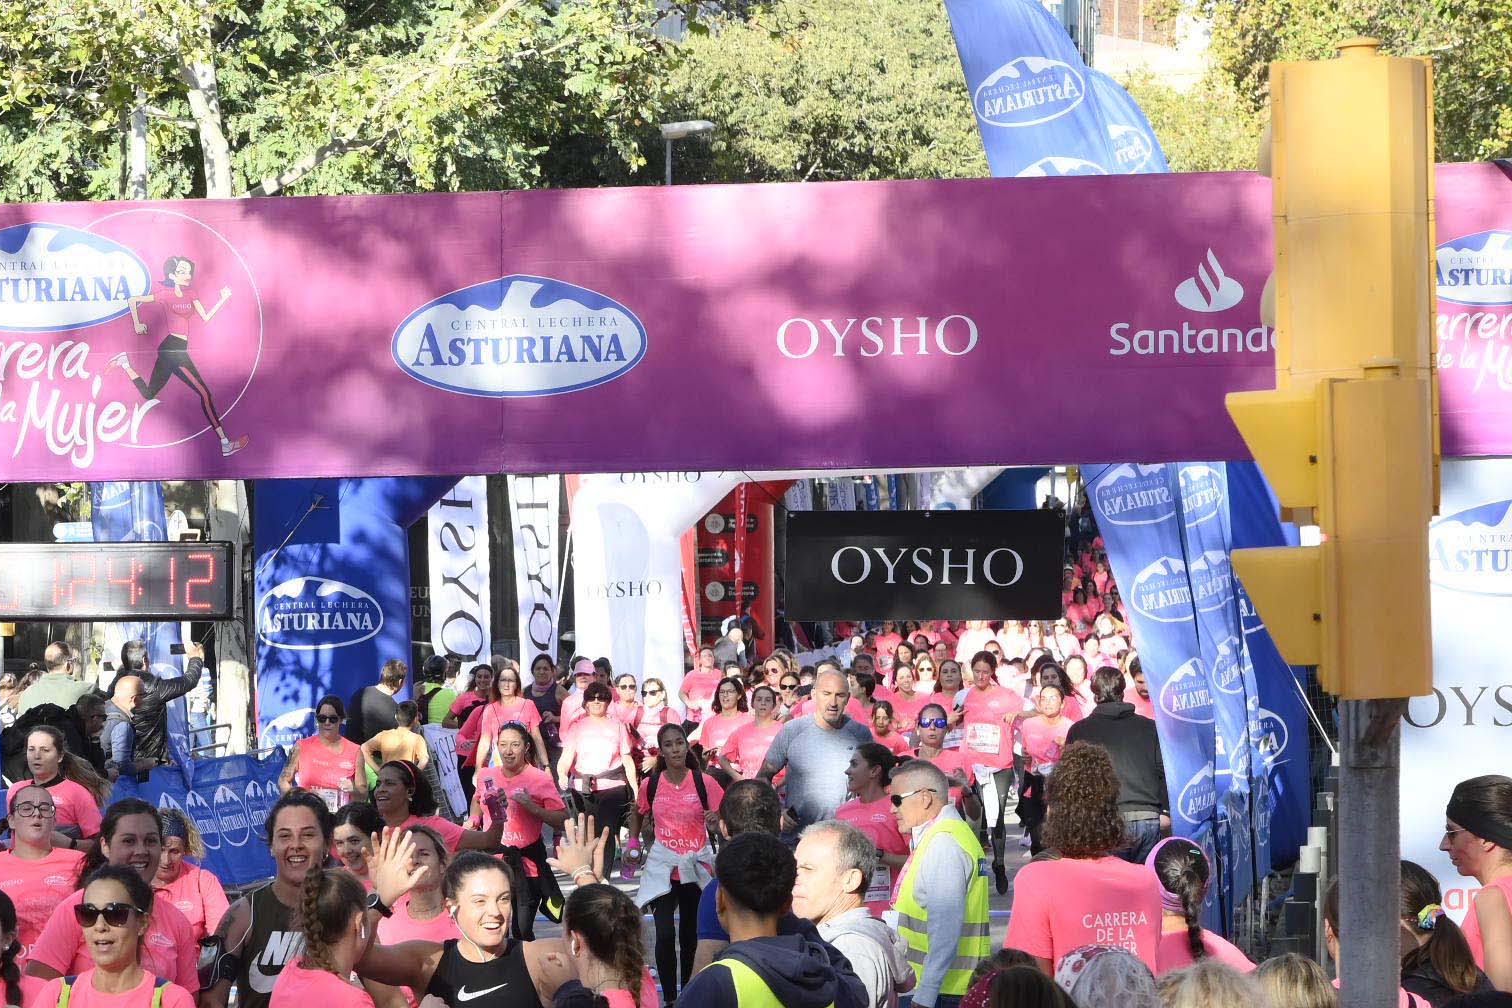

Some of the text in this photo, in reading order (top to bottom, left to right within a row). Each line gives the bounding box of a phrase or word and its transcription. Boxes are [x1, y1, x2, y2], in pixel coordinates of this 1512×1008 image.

[451, 315, 619, 331] CENTRAL LECHERA
[776, 315, 978, 358] OYSHO
[412, 322, 628, 367] ASTURIANA
[14, 374, 161, 469] Mujer
[831, 546, 1024, 586] OYSHO
[274, 601, 369, 610] CENTRAL LECHERA
[260, 606, 374, 633] ASTURIANA
[1082, 911, 1148, 929] CARRERA
[1097, 927, 1135, 942] DE LA
